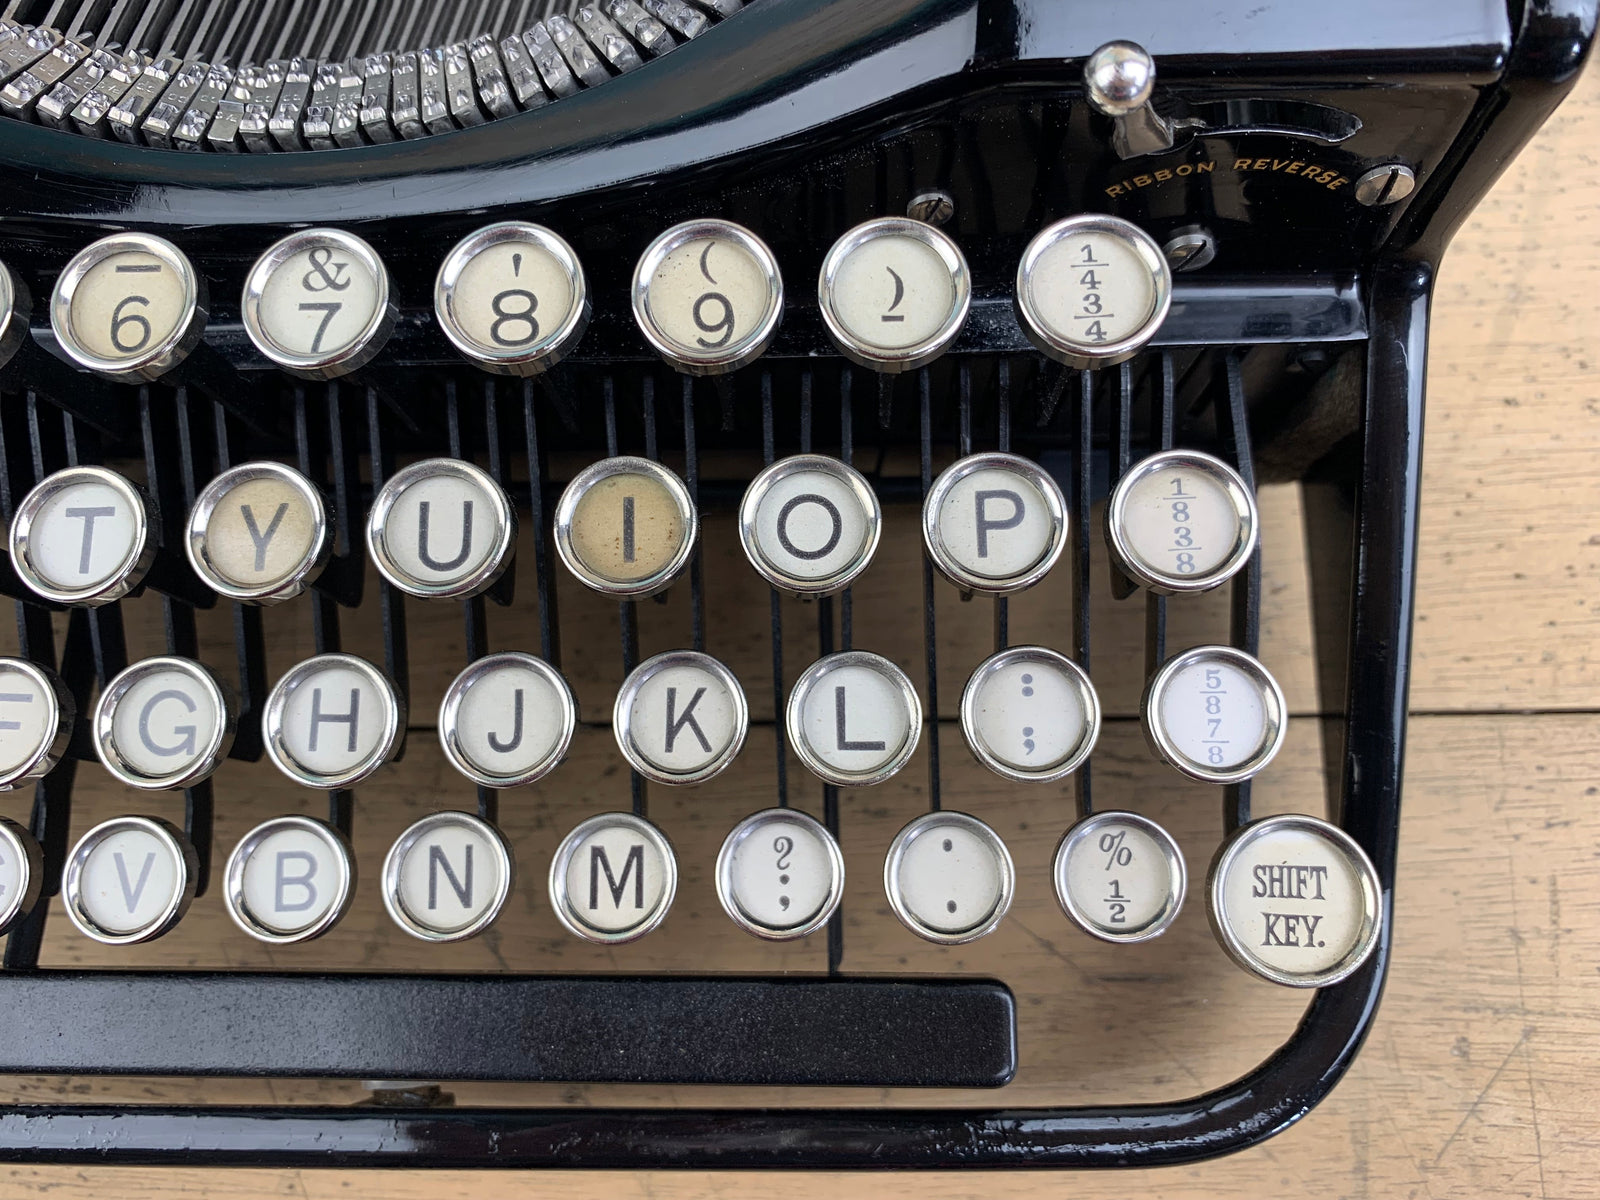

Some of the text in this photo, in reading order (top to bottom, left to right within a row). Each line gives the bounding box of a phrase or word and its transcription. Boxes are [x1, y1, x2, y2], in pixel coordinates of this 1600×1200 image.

[1105, 158, 1350, 198] RIBBON REVERSE
[303, 248, 352, 291] &
[110, 296, 151, 352] 6
[298, 302, 341, 354] 7
[491, 290, 539, 346] 8
[693, 292, 734, 347] 9
[65, 506, 115, 574] T
[240, 503, 289, 571] Y
[418, 500, 473, 572] U
[622, 496, 638, 563] I
[777, 494, 842, 560] O
[975, 489, 1025, 558] P
[139, 690, 197, 756] G
[308, 688, 360, 752] H
[488, 689, 524, 753] J
[665, 687, 713, 753] K
[835, 686, 886, 751] L
[114, 853, 156, 913] V
[275, 851, 317, 912] B
[428, 844, 473, 910] N
[589, 844, 644, 910] M
[1099, 831, 1132, 871] %
[1252, 863, 1328, 900] SHIFT
[1260, 912, 1326, 948] KEY.
